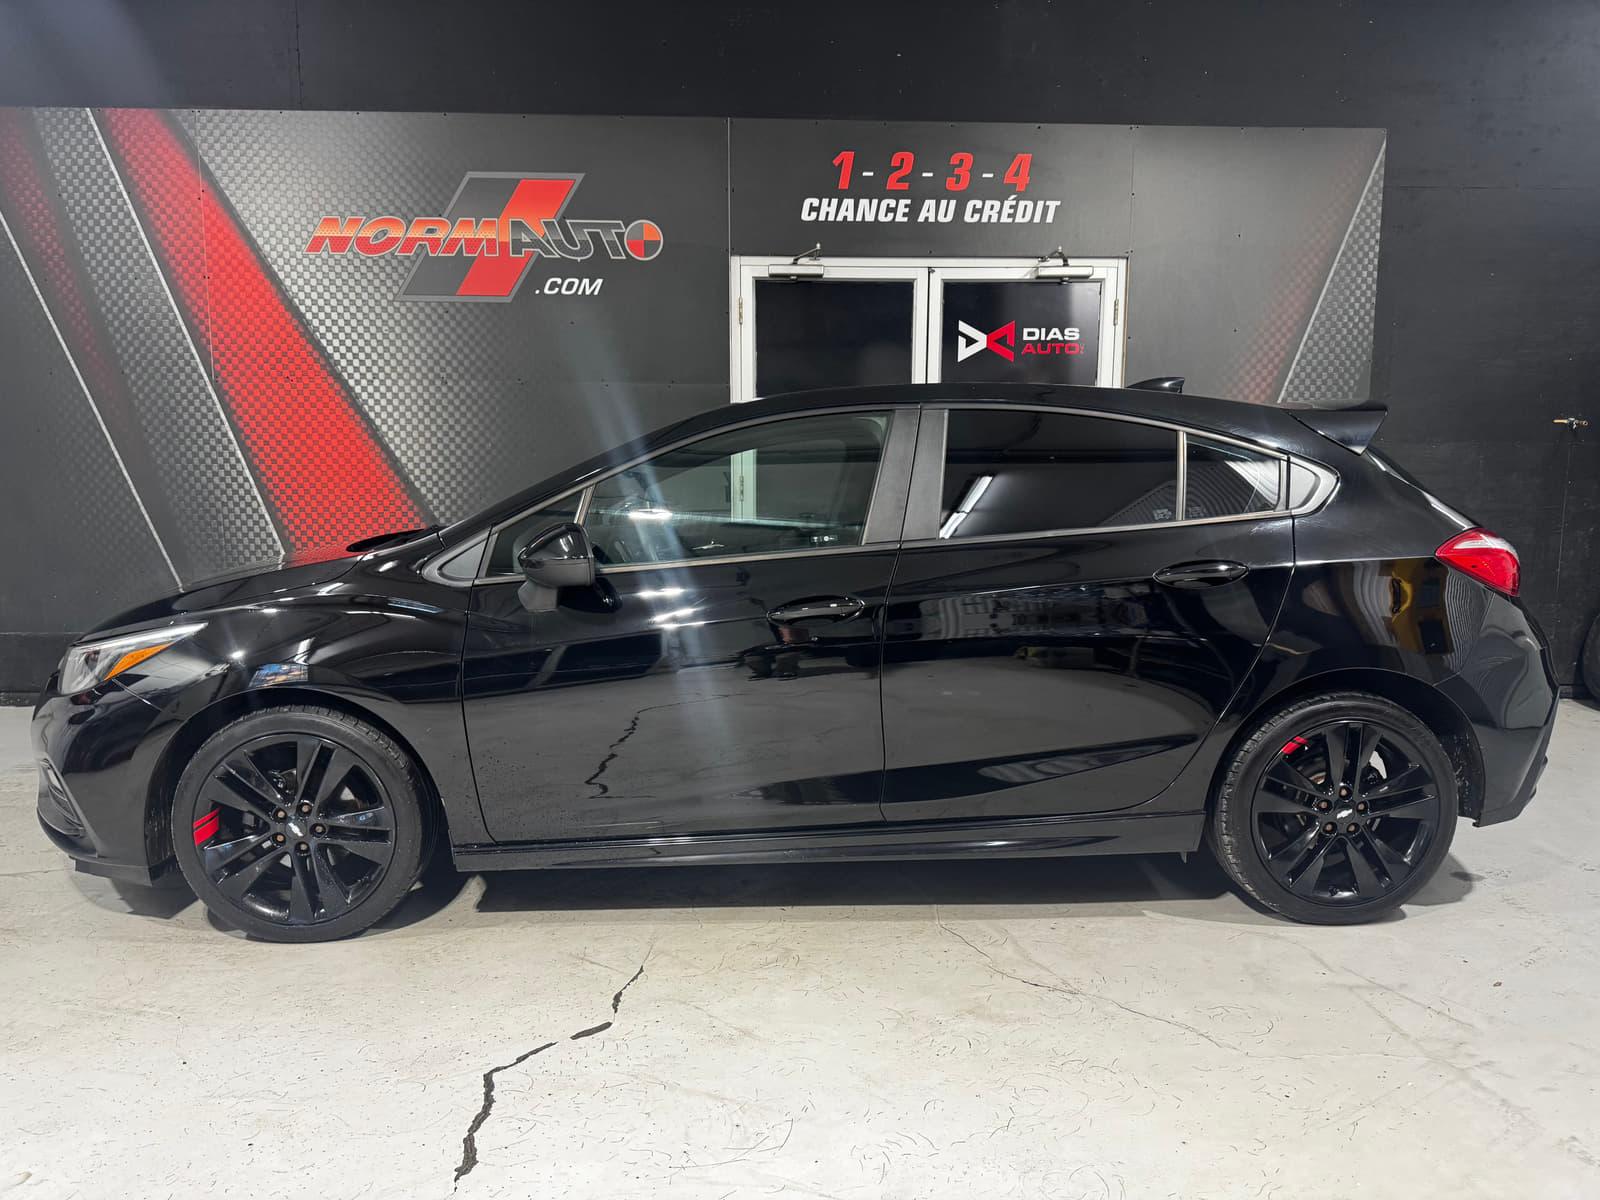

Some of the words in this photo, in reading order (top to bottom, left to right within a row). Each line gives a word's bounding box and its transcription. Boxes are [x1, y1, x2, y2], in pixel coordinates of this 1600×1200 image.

[800, 197, 912, 222] CHANCE
[917, 198, 955, 223] AU
[963, 194, 1062, 223] CRÉDIT
[534, 277, 604, 296] .COM
[1022, 327, 1081, 341] DIAS
[1021, 342, 1080, 355] AUTO
